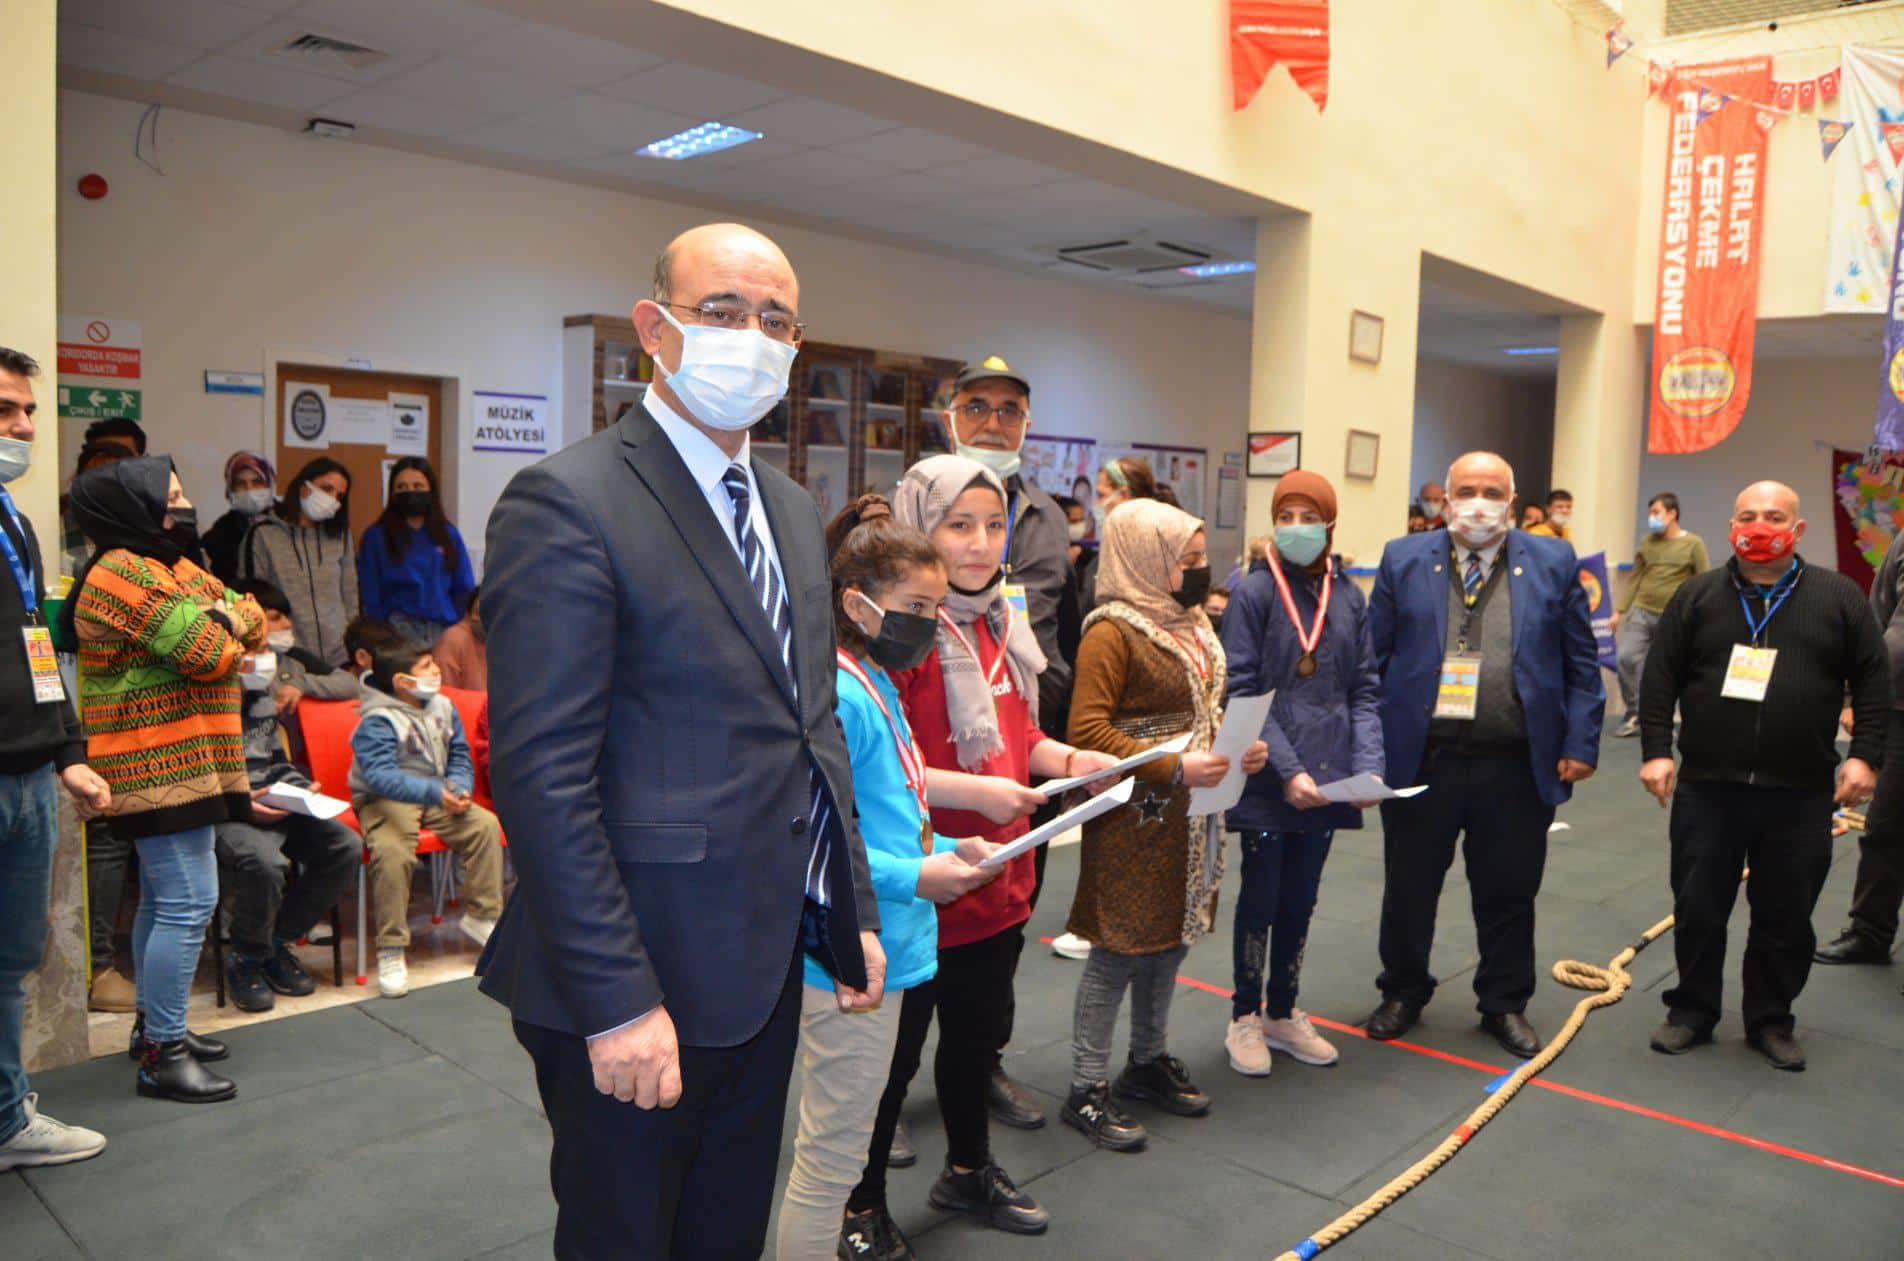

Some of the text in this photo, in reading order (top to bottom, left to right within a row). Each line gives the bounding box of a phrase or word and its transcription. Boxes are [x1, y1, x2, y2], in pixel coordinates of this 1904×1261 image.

[1660, 91, 1699, 335] FEDERASYONU
[1695, 155, 1725, 268] ÇEKME
[1726, 152, 1757, 265] HALAT
[476, 424, 545, 442] ATÖLYESİ
[487, 403, 535, 421] MÜZİK
